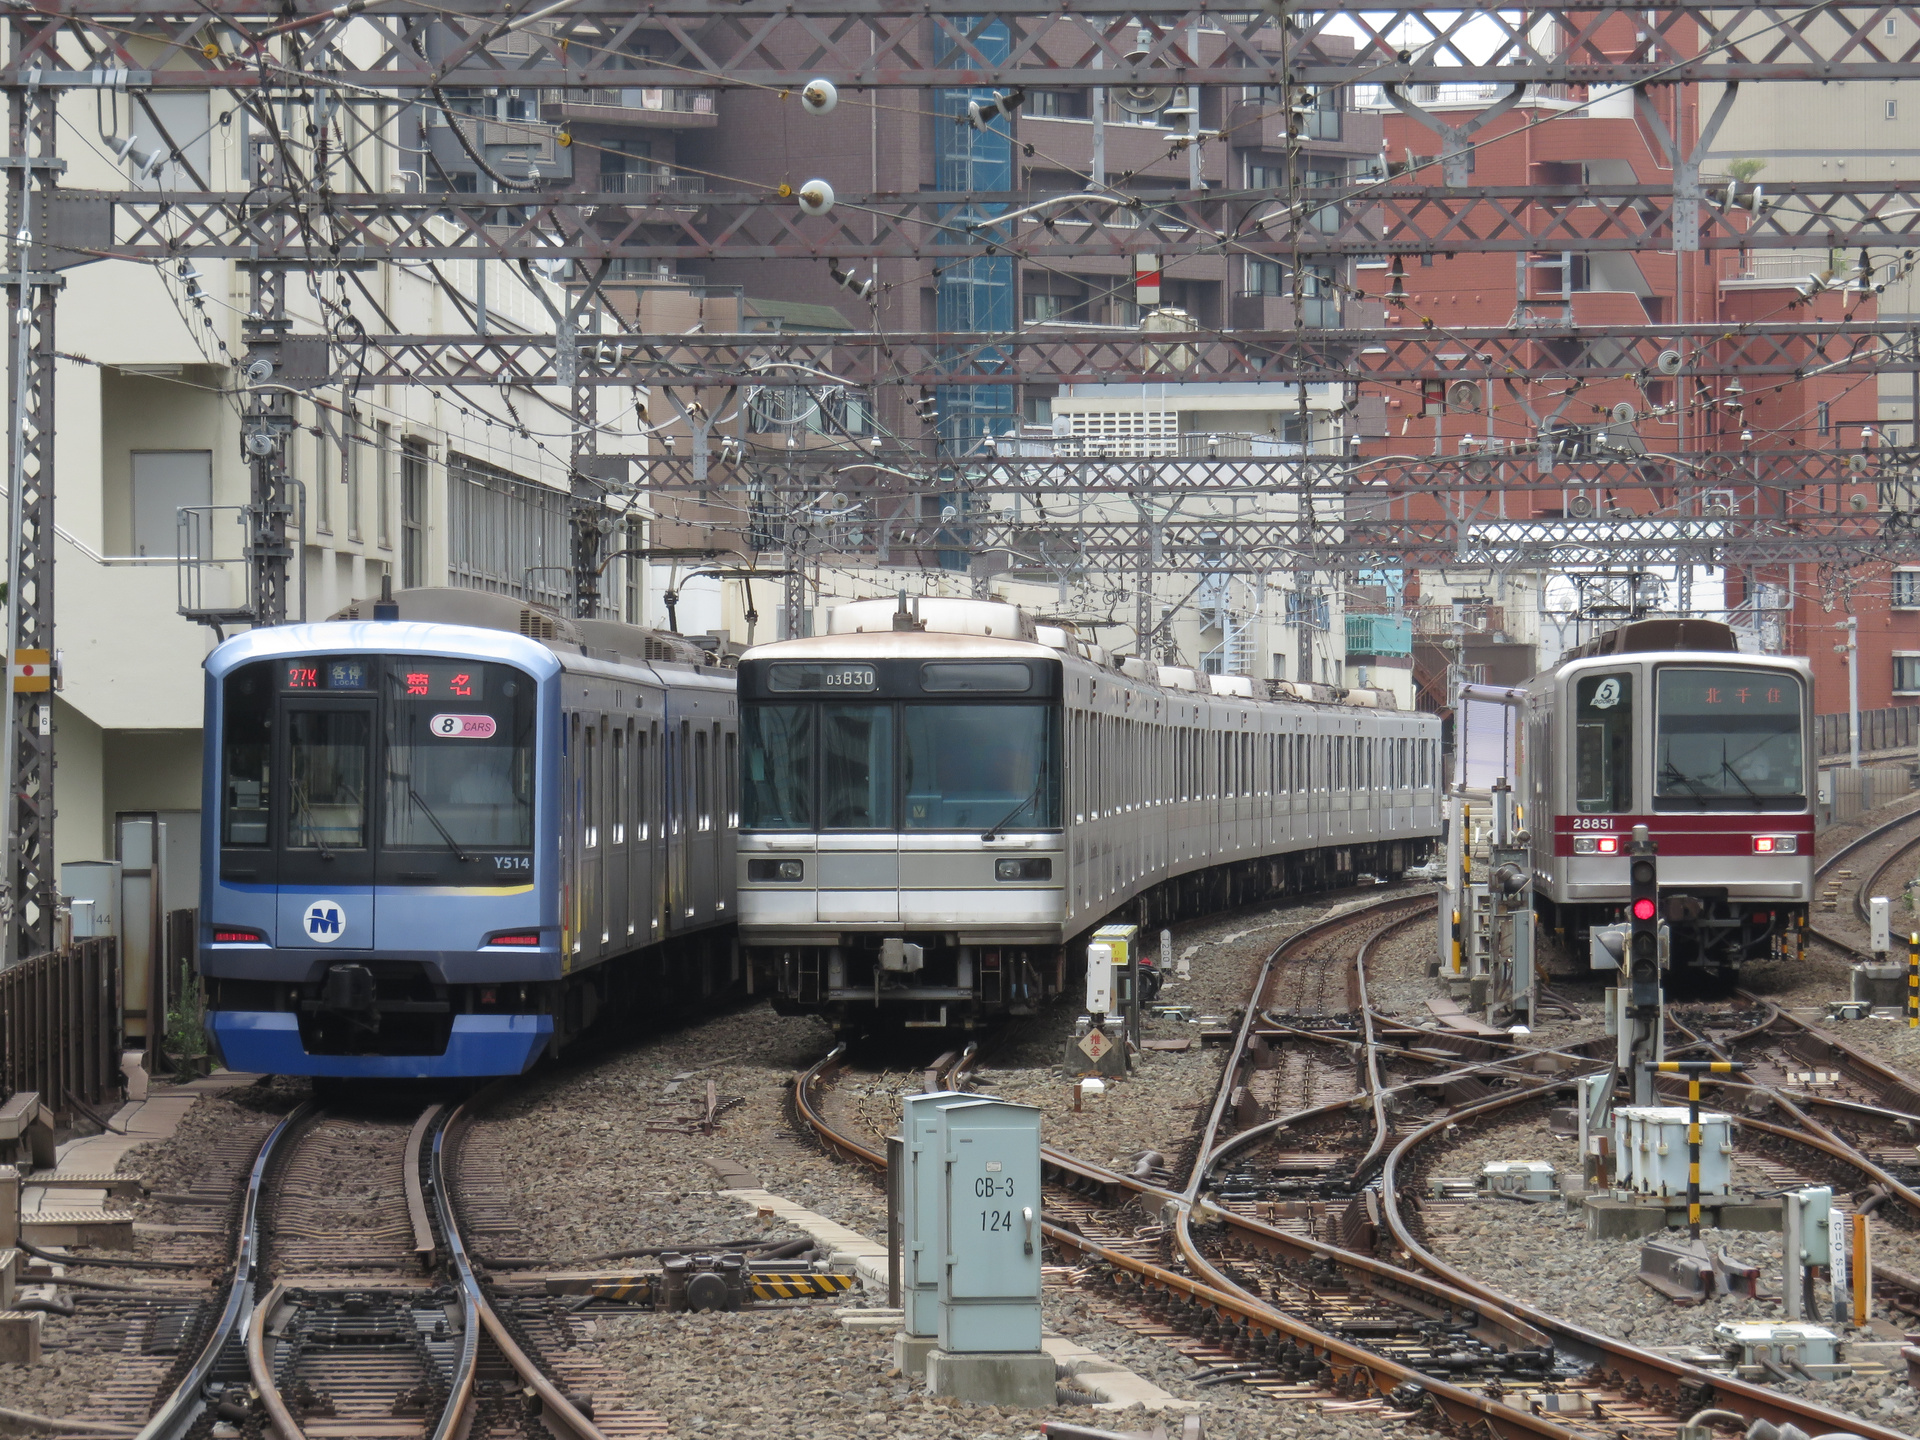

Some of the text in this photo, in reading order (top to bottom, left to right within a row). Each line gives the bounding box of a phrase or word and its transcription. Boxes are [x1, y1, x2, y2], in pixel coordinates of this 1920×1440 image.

[332, 665, 362, 680] 各停
[826, 671, 873, 685] 03830
[406, 673, 471, 696] 菊名
[1600, 684, 1615, 700] 5
[1705, 688, 1782, 704] 北千住
[41, 717, 48, 726] 6
[442, 718, 492, 733] 8 CARS
[1573, 818, 1613, 830] 28851
[494, 856, 530, 870] Y514
[975, 1177, 1014, 1198] CB-3
[981, 1210, 1012, 1232] 124
